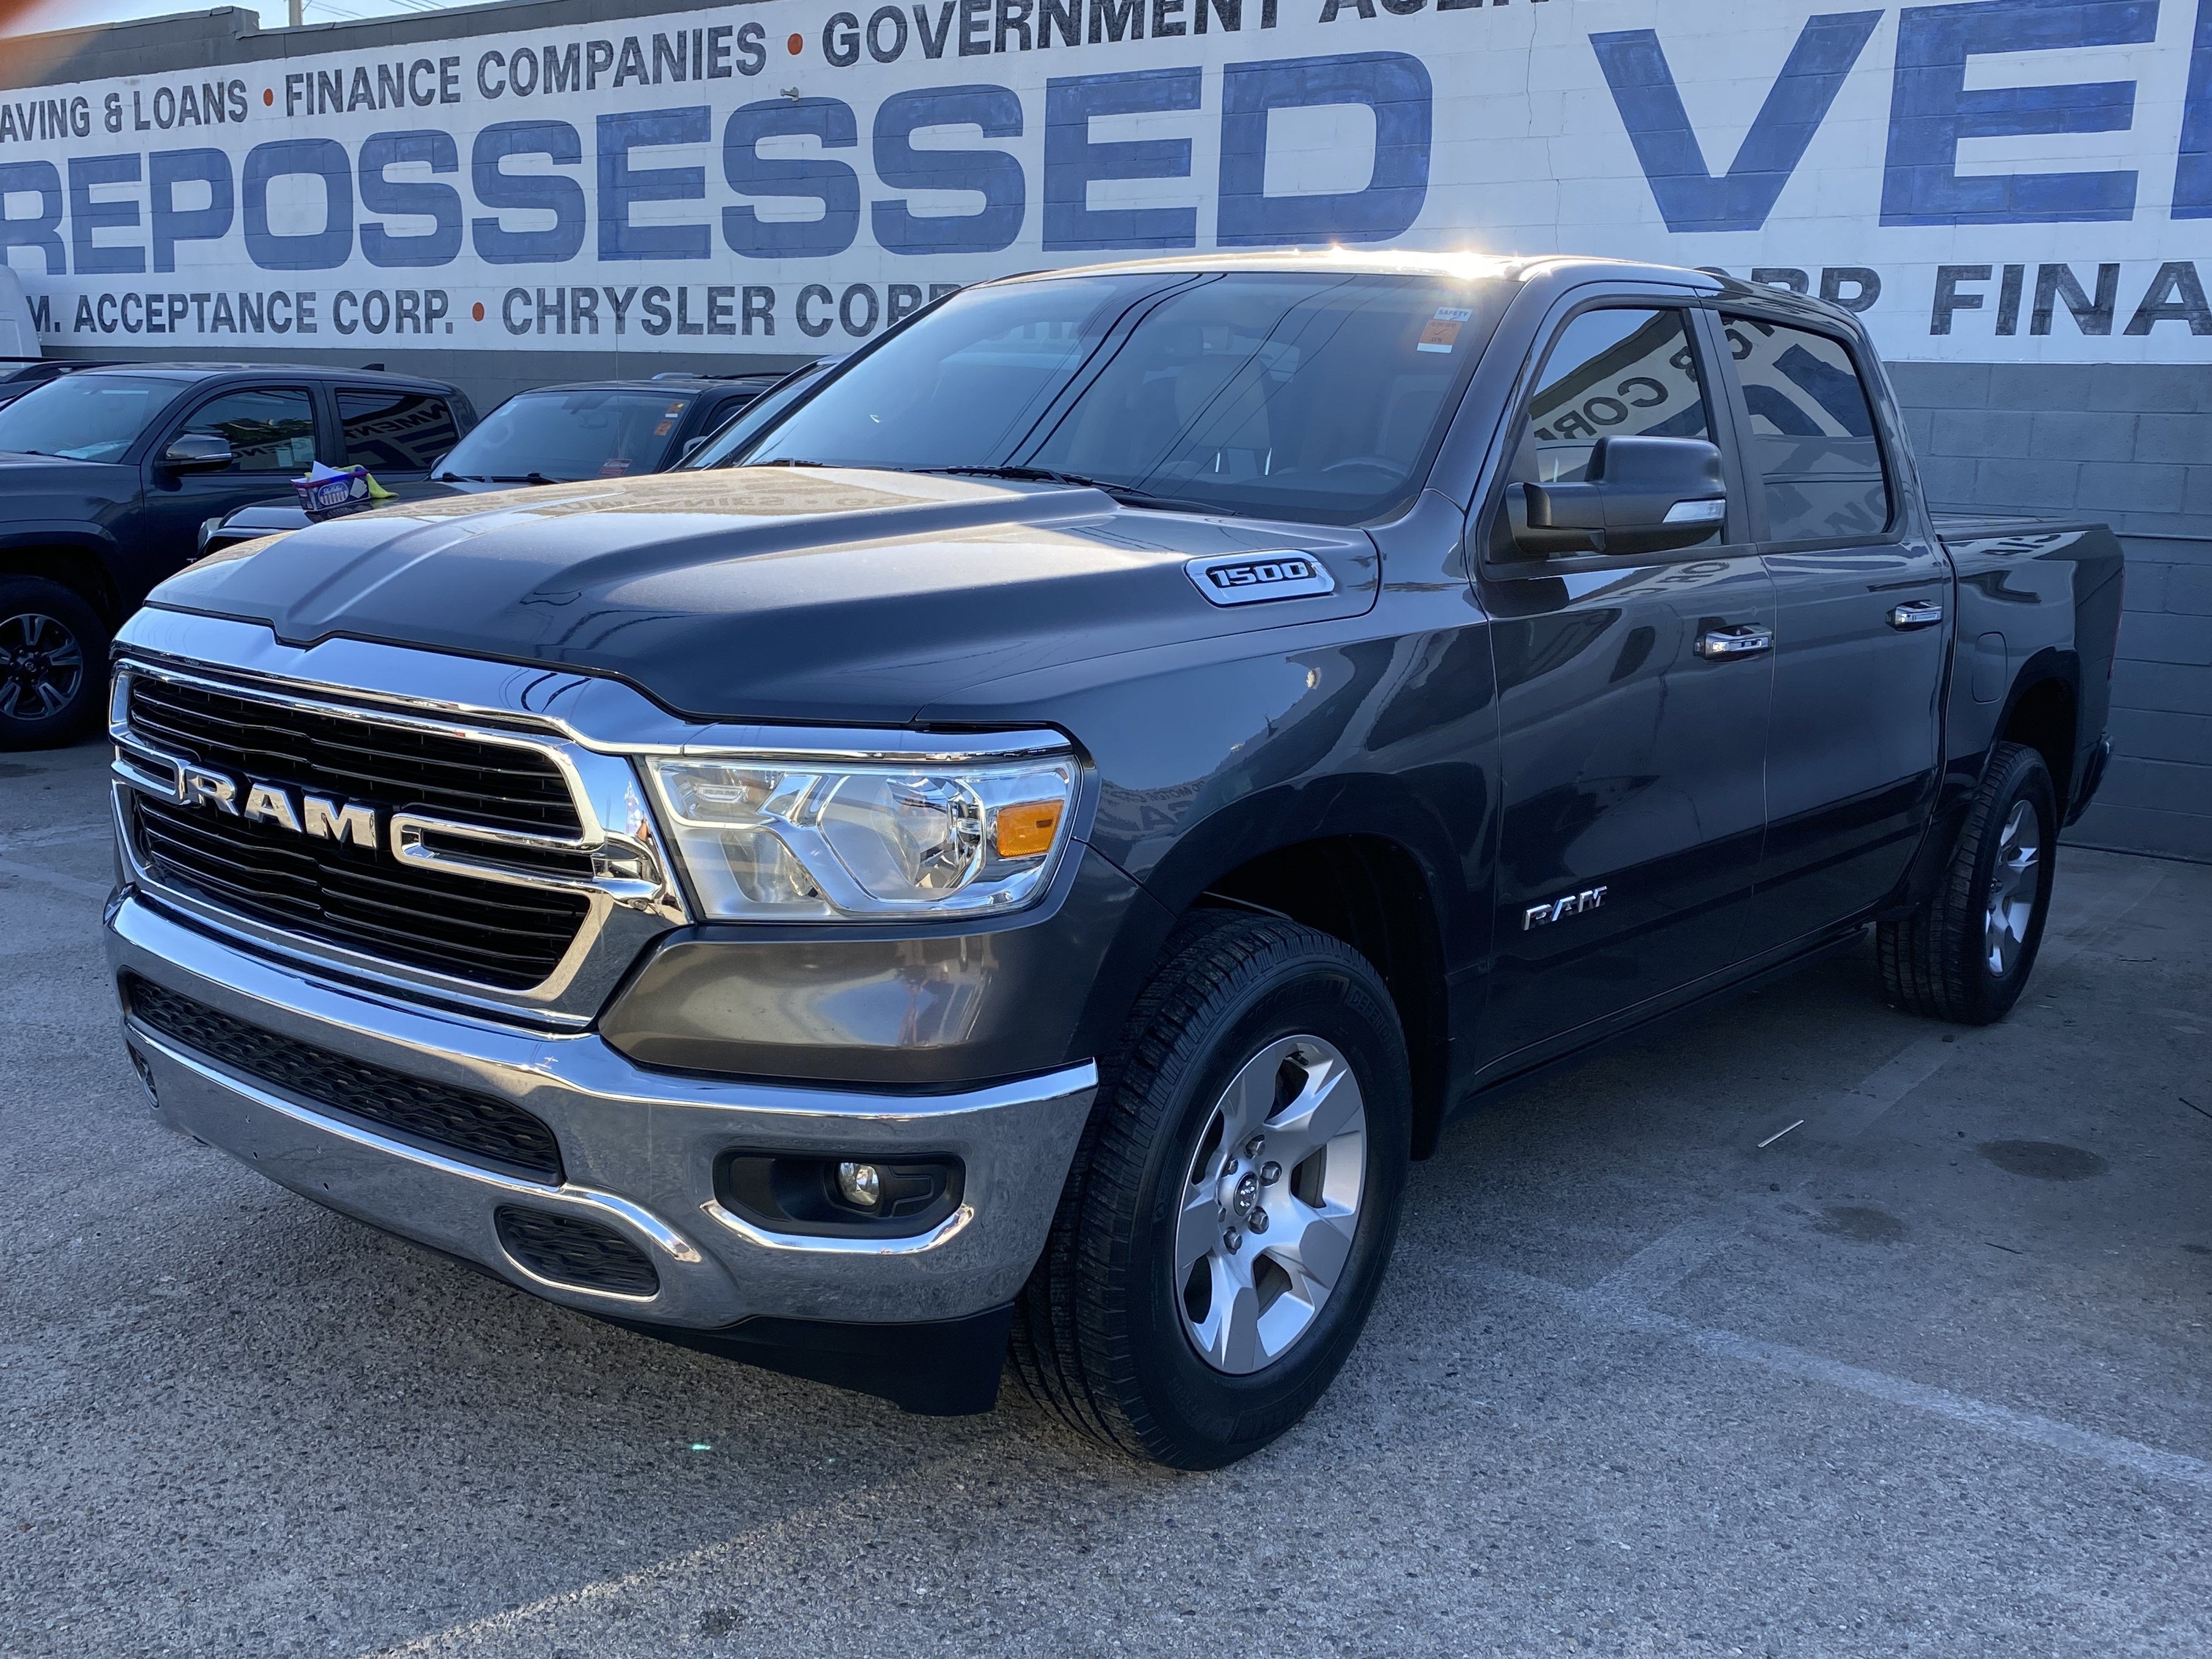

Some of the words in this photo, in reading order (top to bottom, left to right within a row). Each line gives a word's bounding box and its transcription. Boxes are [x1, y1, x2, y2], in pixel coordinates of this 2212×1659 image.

[0, 96, 90, 143] AVING
[104, 92, 122, 133] &
[133, 80, 248, 132] LOANS
[286, 56, 461, 117] FINANCE
[477, 22, 767, 100] COMPANIES
[0, 50, 1433, 275] REPOSSESSED
[74, 291, 318, 334] ACCEPTANCE
[332, 290, 454, 335] CORP.
[502, 286, 776, 336] CHRYSLER
[795, 283, 962, 338] COR
[1929, 261, 2212, 336] FINA
[1209, 561, 1309, 586] 1500
[187, 765, 379, 850] RAM
[1522, 885, 1607, 931] RAM
